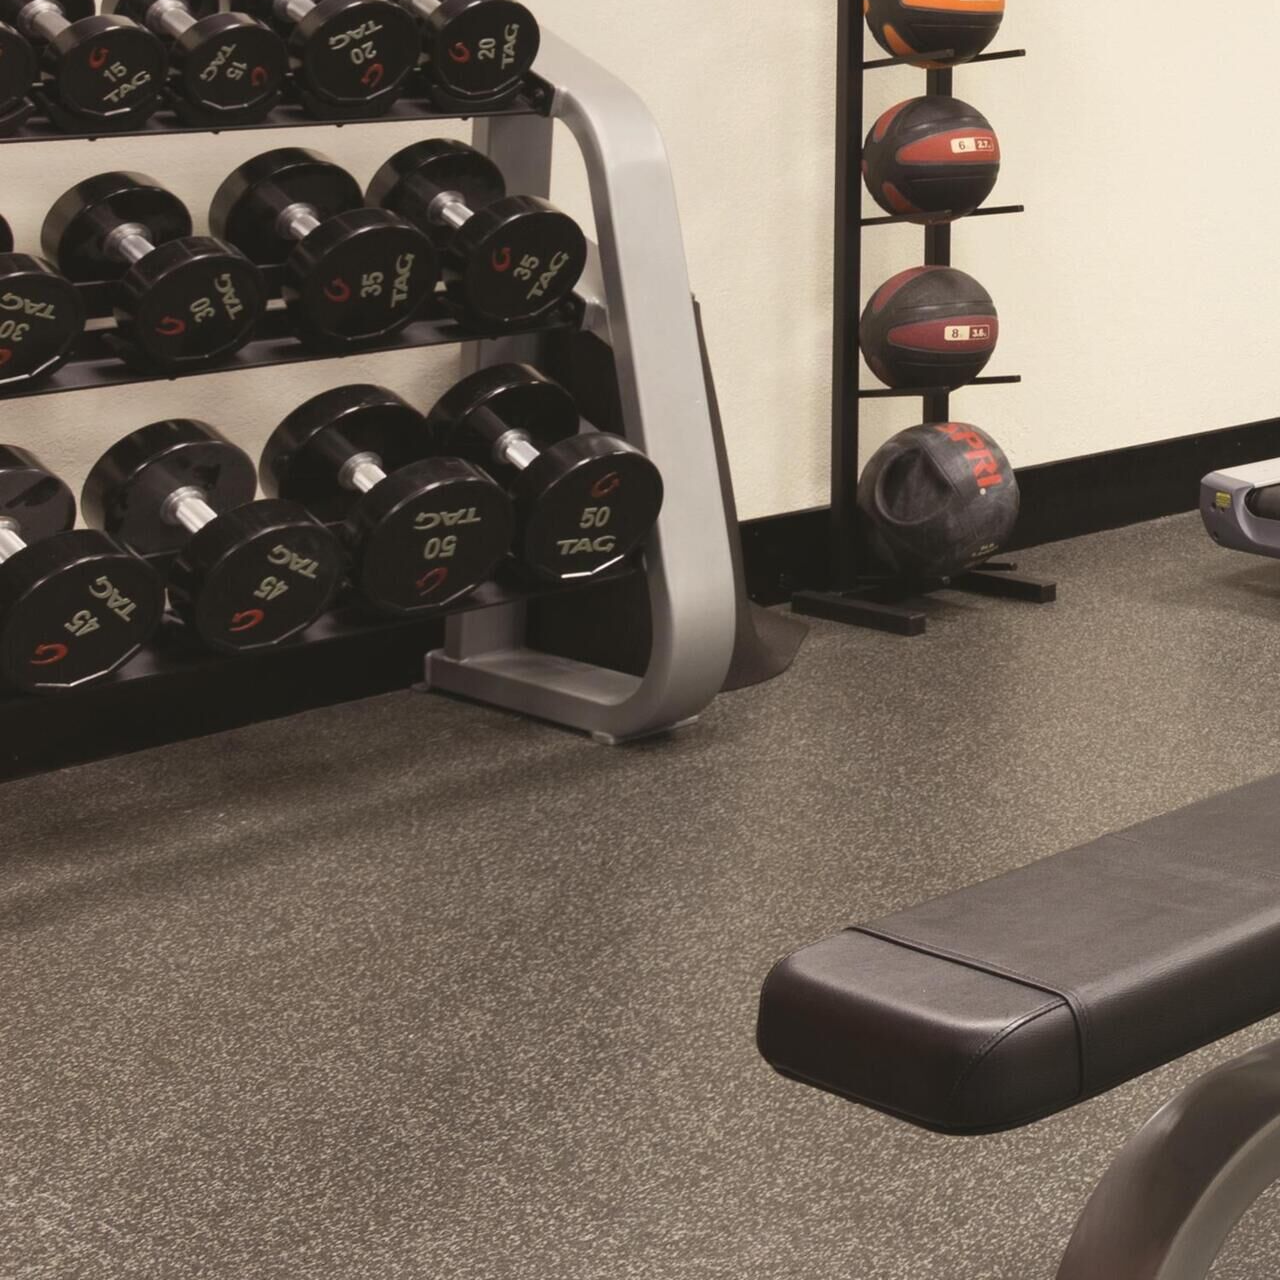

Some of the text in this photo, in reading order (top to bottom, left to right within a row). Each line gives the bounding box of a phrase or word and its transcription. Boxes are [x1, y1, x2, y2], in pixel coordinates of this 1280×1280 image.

[327, 20, 383, 52] TAG
[477, 36, 497, 61] 20
[500, 22, 520, 70] TAG
[199, 42, 237, 83] TAG
[349, 41, 378, 66] 20
[104, 61, 127, 82] 15
[225, 59, 247, 82] 15
[102, 70, 152, 104] TAG
[390, 252, 415, 309] TAG
[512, 254, 541, 286] 35
[526, 250, 570, 301] TAG
[214, 273, 244, 321] TAG
[359, 270, 384, 300] 35
[189, 297, 216, 323] 30
[412, 507, 482, 531] TAG
[578, 506, 611, 530] 50
[423, 534, 458, 561] 50
[556, 534, 617, 556] TAG
[265, 543, 320, 580] TAG
[88, 575, 137, 623] TAG
[252, 574, 291, 602] 45
[64, 609, 101, 637] 45
